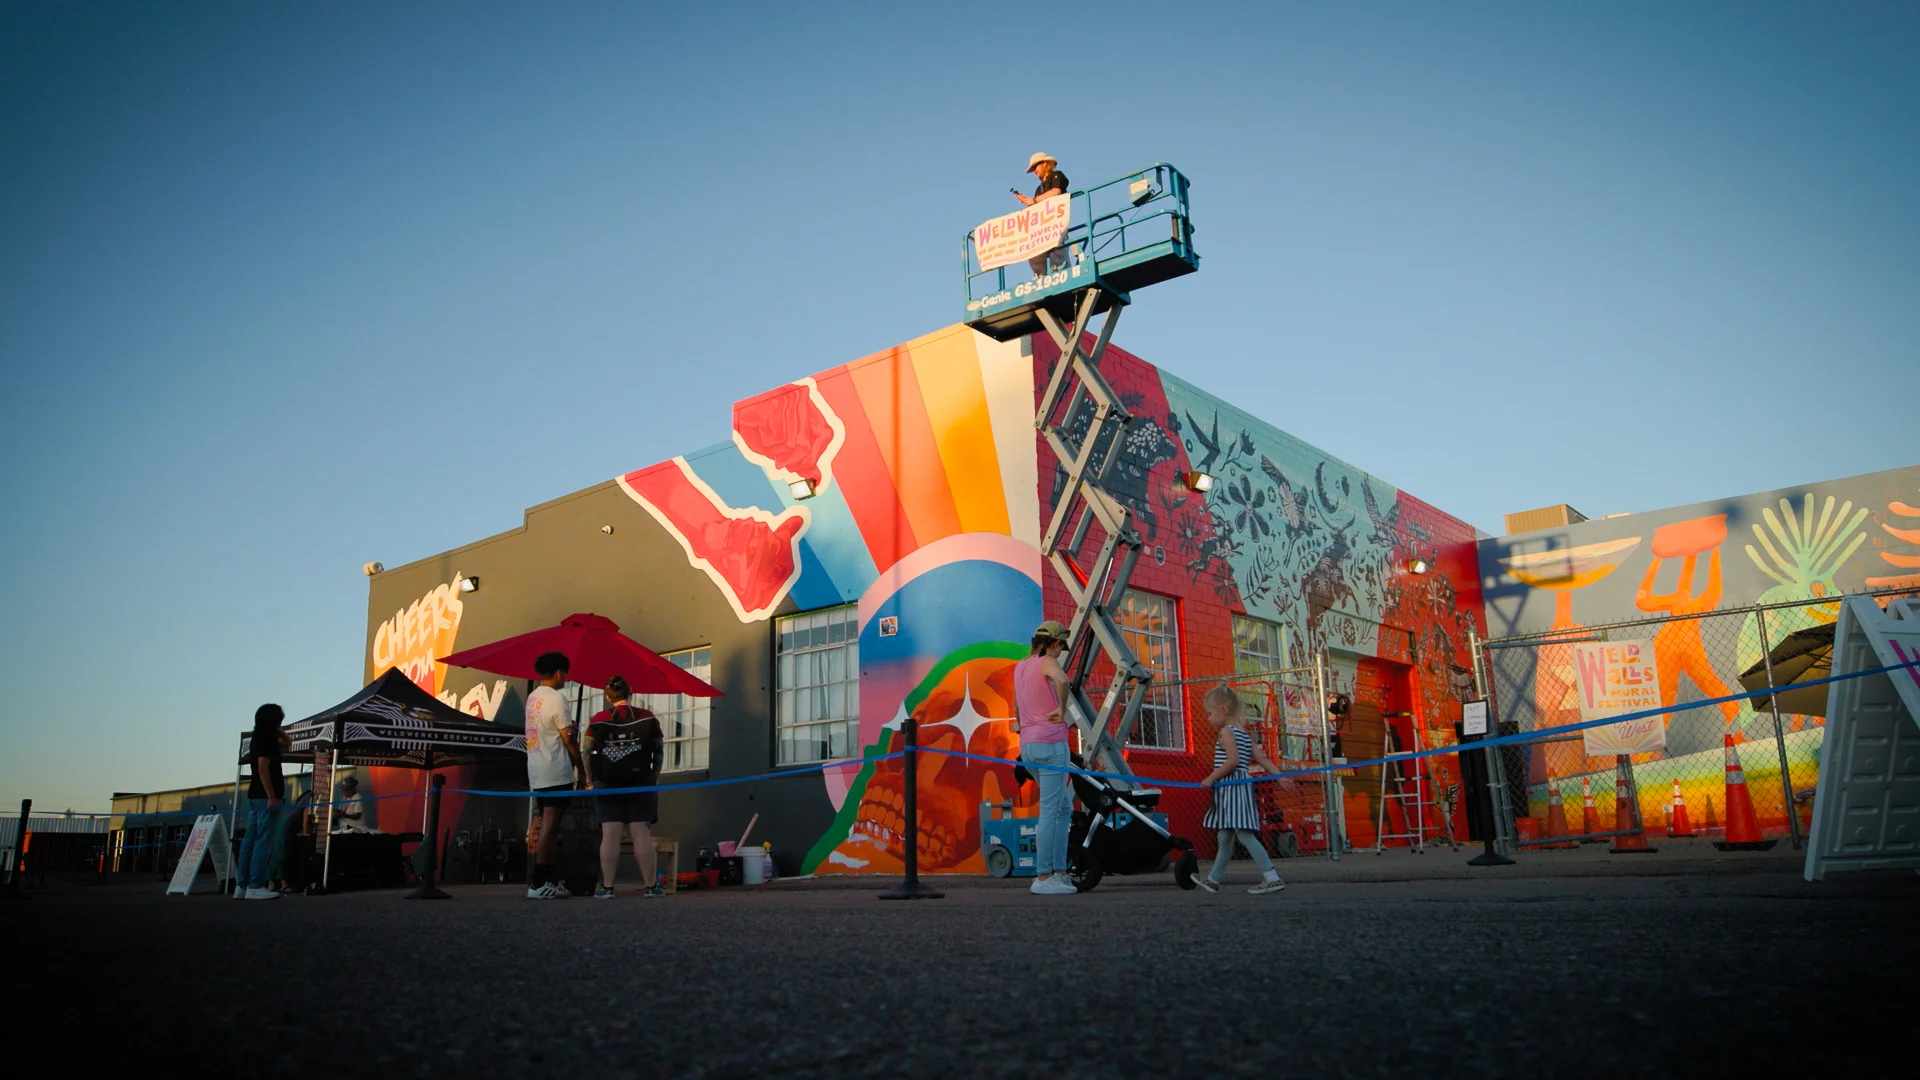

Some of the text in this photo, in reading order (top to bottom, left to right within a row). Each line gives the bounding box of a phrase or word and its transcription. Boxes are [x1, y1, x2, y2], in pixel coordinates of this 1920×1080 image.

[1020, 230, 1064, 252] FESTIVAL
[1031, 222, 1064, 241] MURAL
[980, 271, 1068, 308] Genie GS-1930
[373, 571, 463, 668] CHEERS
[1611, 686, 1656, 697] MURAL
[1598, 698, 1657, 708] FESTIVAL
[379, 729, 438, 740] WELDWERKS
[443, 734, 485, 743] BREWING
[1618, 719, 1655, 739] West
